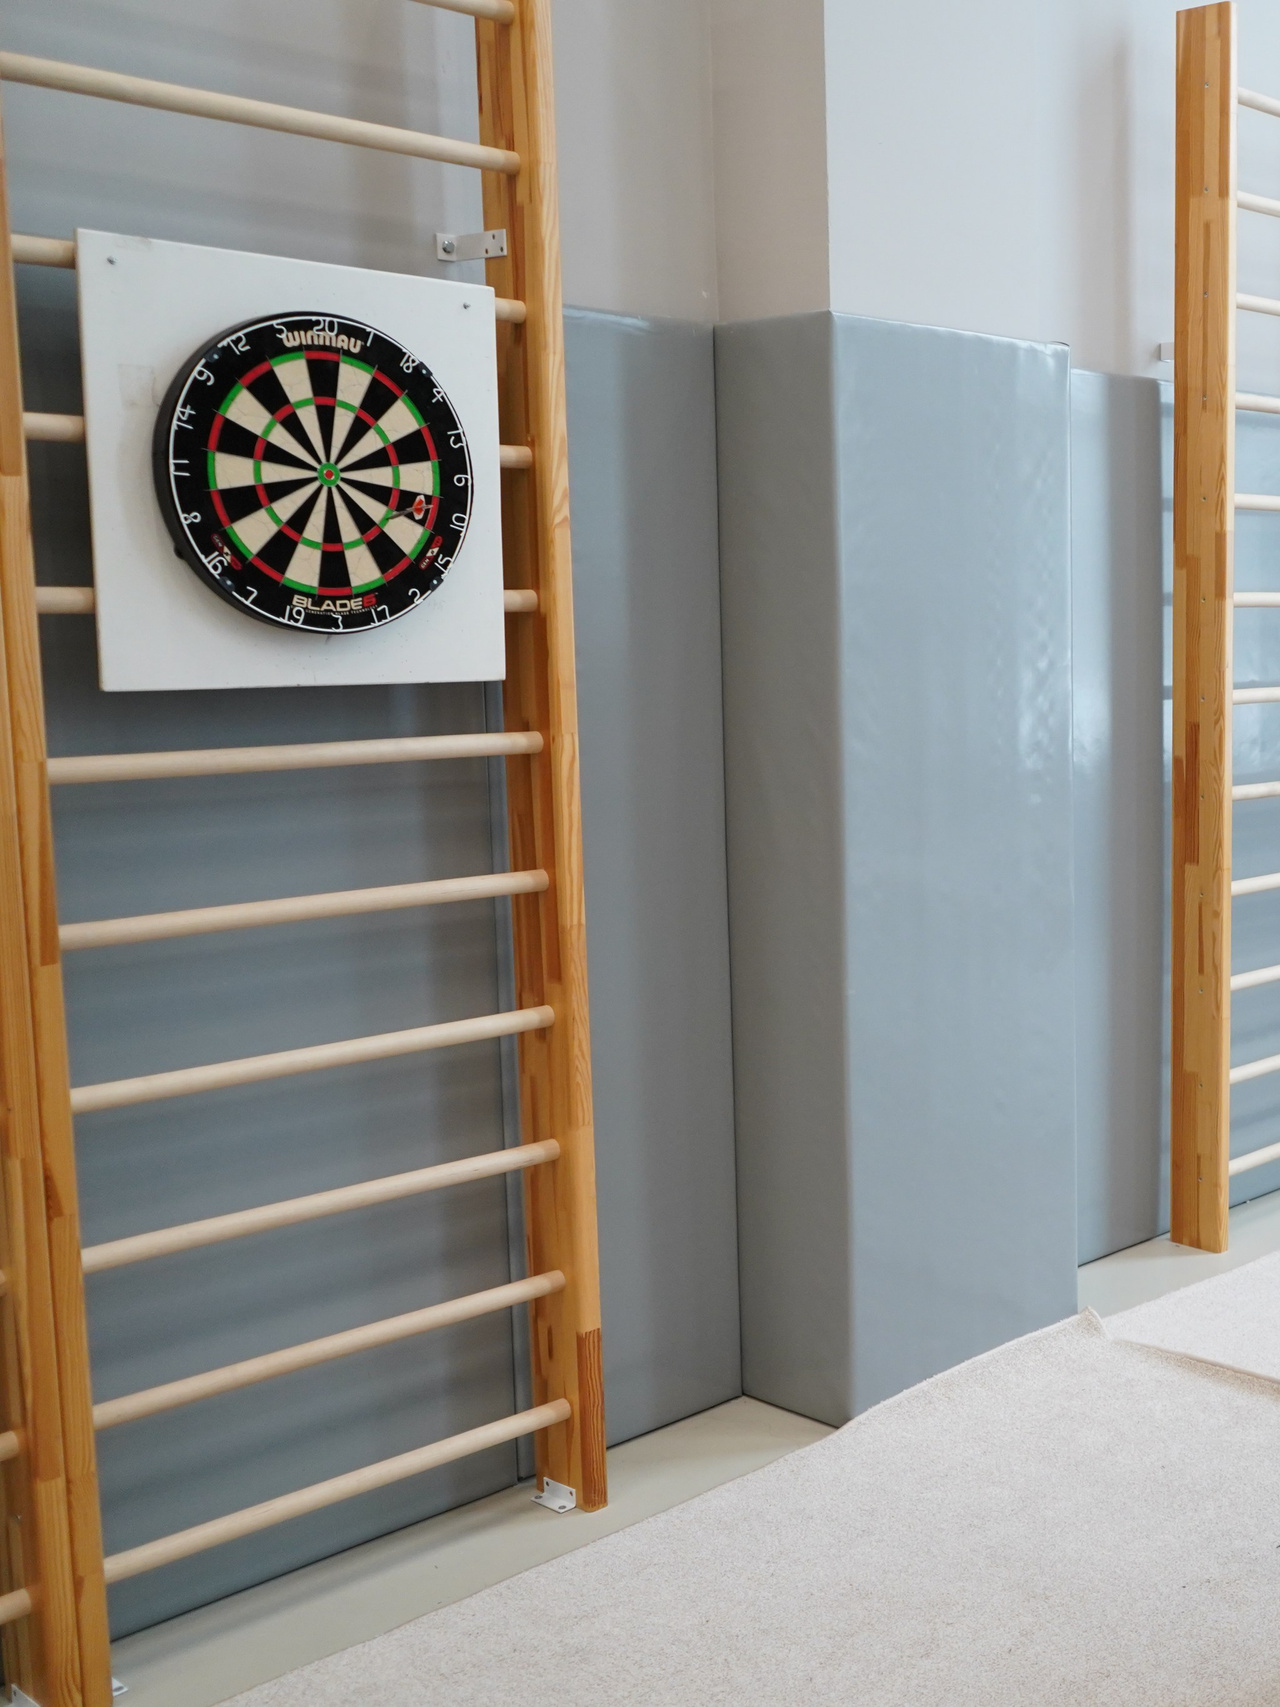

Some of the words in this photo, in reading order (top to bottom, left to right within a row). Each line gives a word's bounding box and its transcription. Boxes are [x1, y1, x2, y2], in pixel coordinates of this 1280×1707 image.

[273, 322, 287, 338] 5
[311, 317, 338, 336] 20
[224, 333, 251, 355] 12
[366, 327, 374, 347] 1
[400, 349, 419, 373] 18
[195, 367, 214, 386] 9
[432, 388, 444, 403] 4
[174, 405, 196, 430] 14
[447, 425, 466, 449] 13
[171, 460, 190, 476] 11
[453, 474, 471, 487] 6
[182, 512, 201, 524] 8
[449, 513, 468, 535] 10
[202, 551, 228, 575] 16
[434, 553, 453, 577] 15
[244, 586, 258, 604] 7
[292, 593, 377, 612] BLADE6
[408, 588, 423, 604] 2
[284, 605, 305, 625] 19
[331, 613, 343, 631] 3
[370, 604, 390, 626] 17
